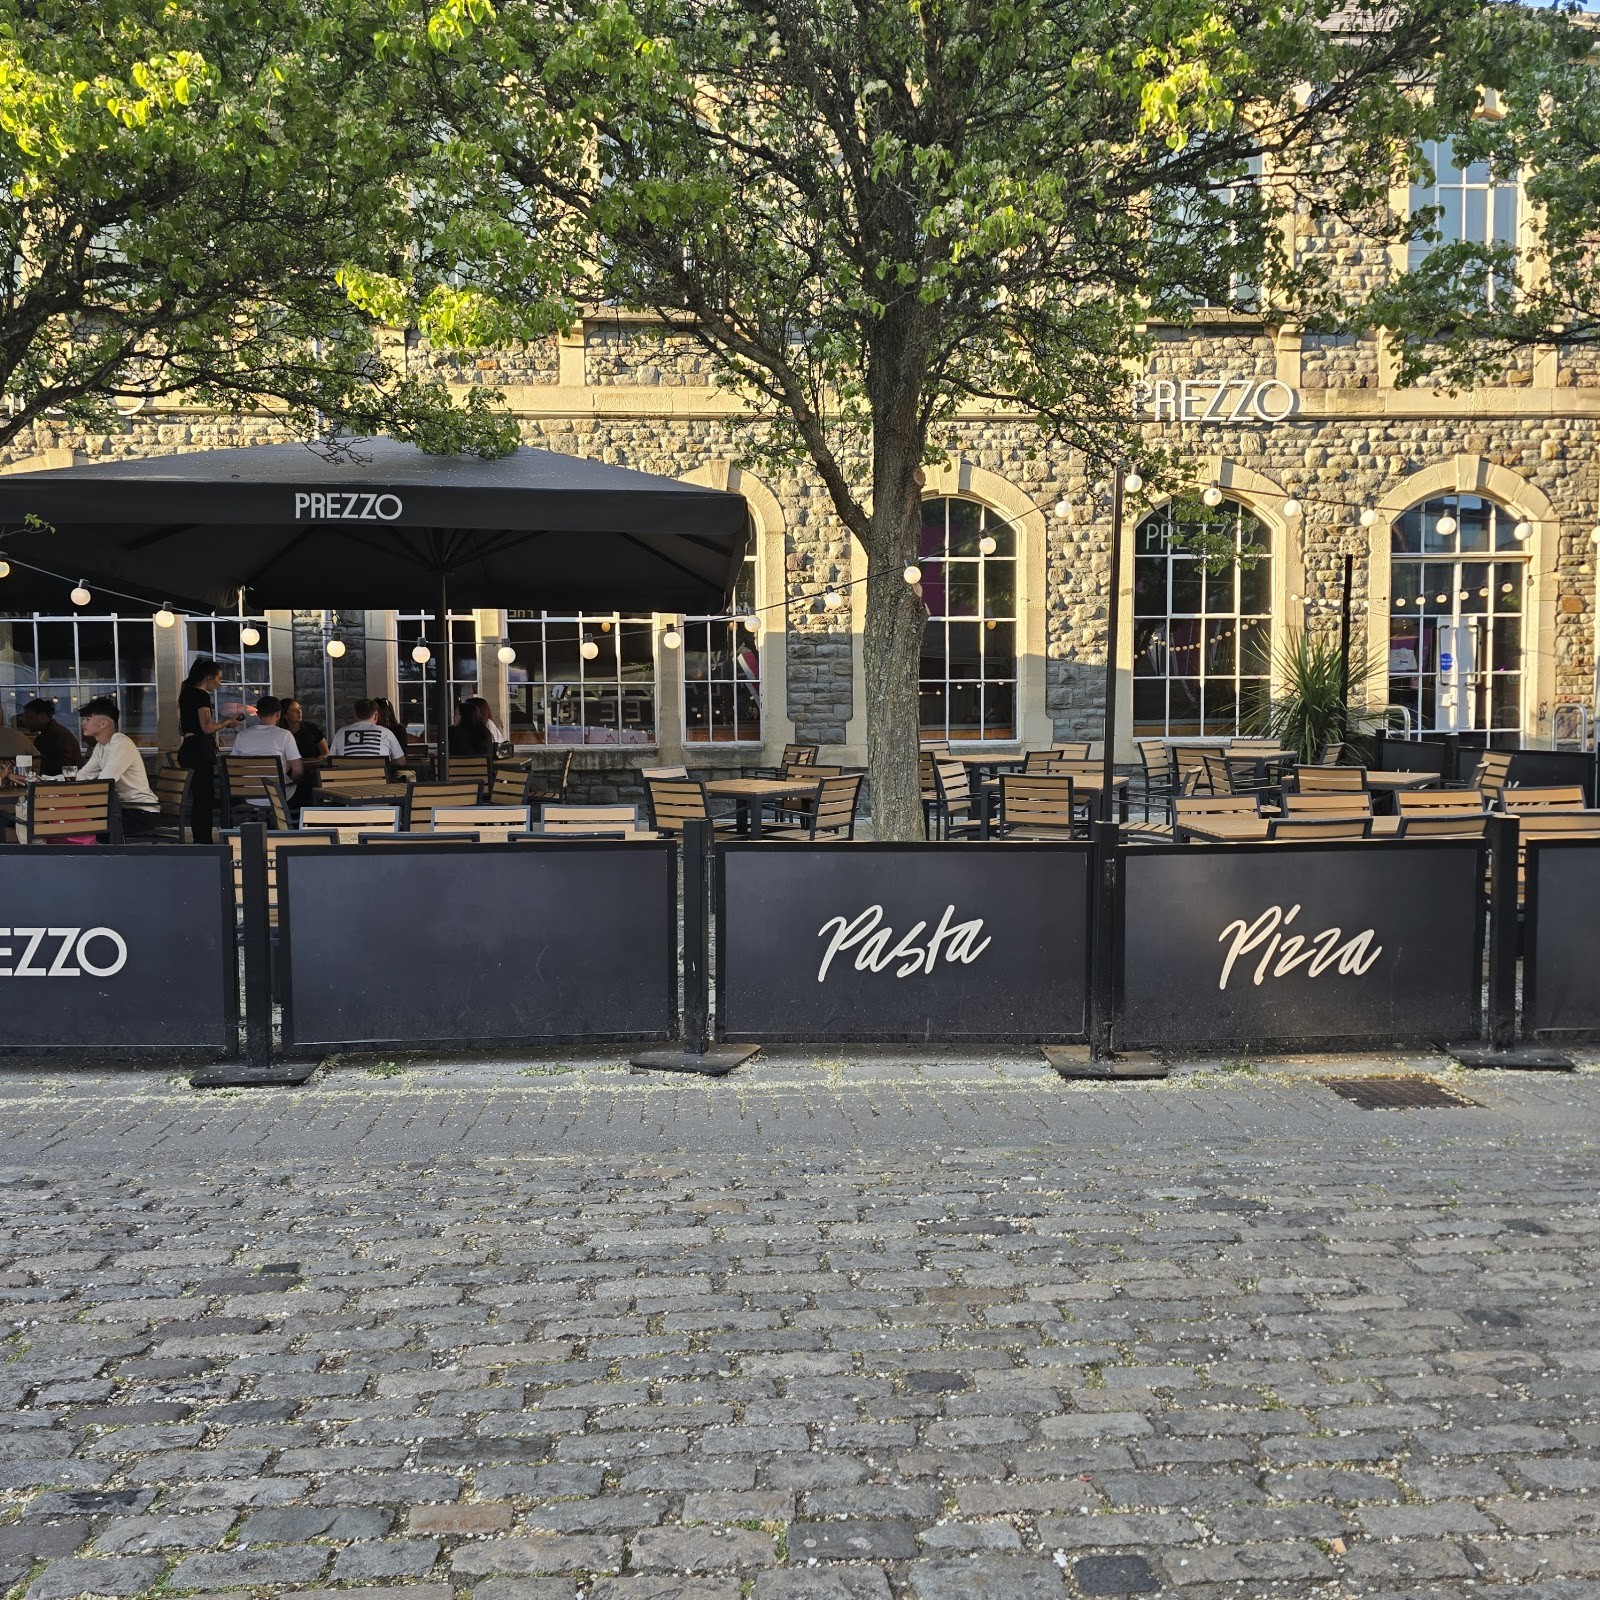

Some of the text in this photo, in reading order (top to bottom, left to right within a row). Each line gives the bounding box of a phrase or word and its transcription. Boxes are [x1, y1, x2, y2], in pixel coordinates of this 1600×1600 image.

[1132, 379, 1294, 422] PREZZO
[294, 492, 403, 520] PREZZO
[817, 904, 992, 983] Pasta
[1218, 903, 1383, 990] Pizza
